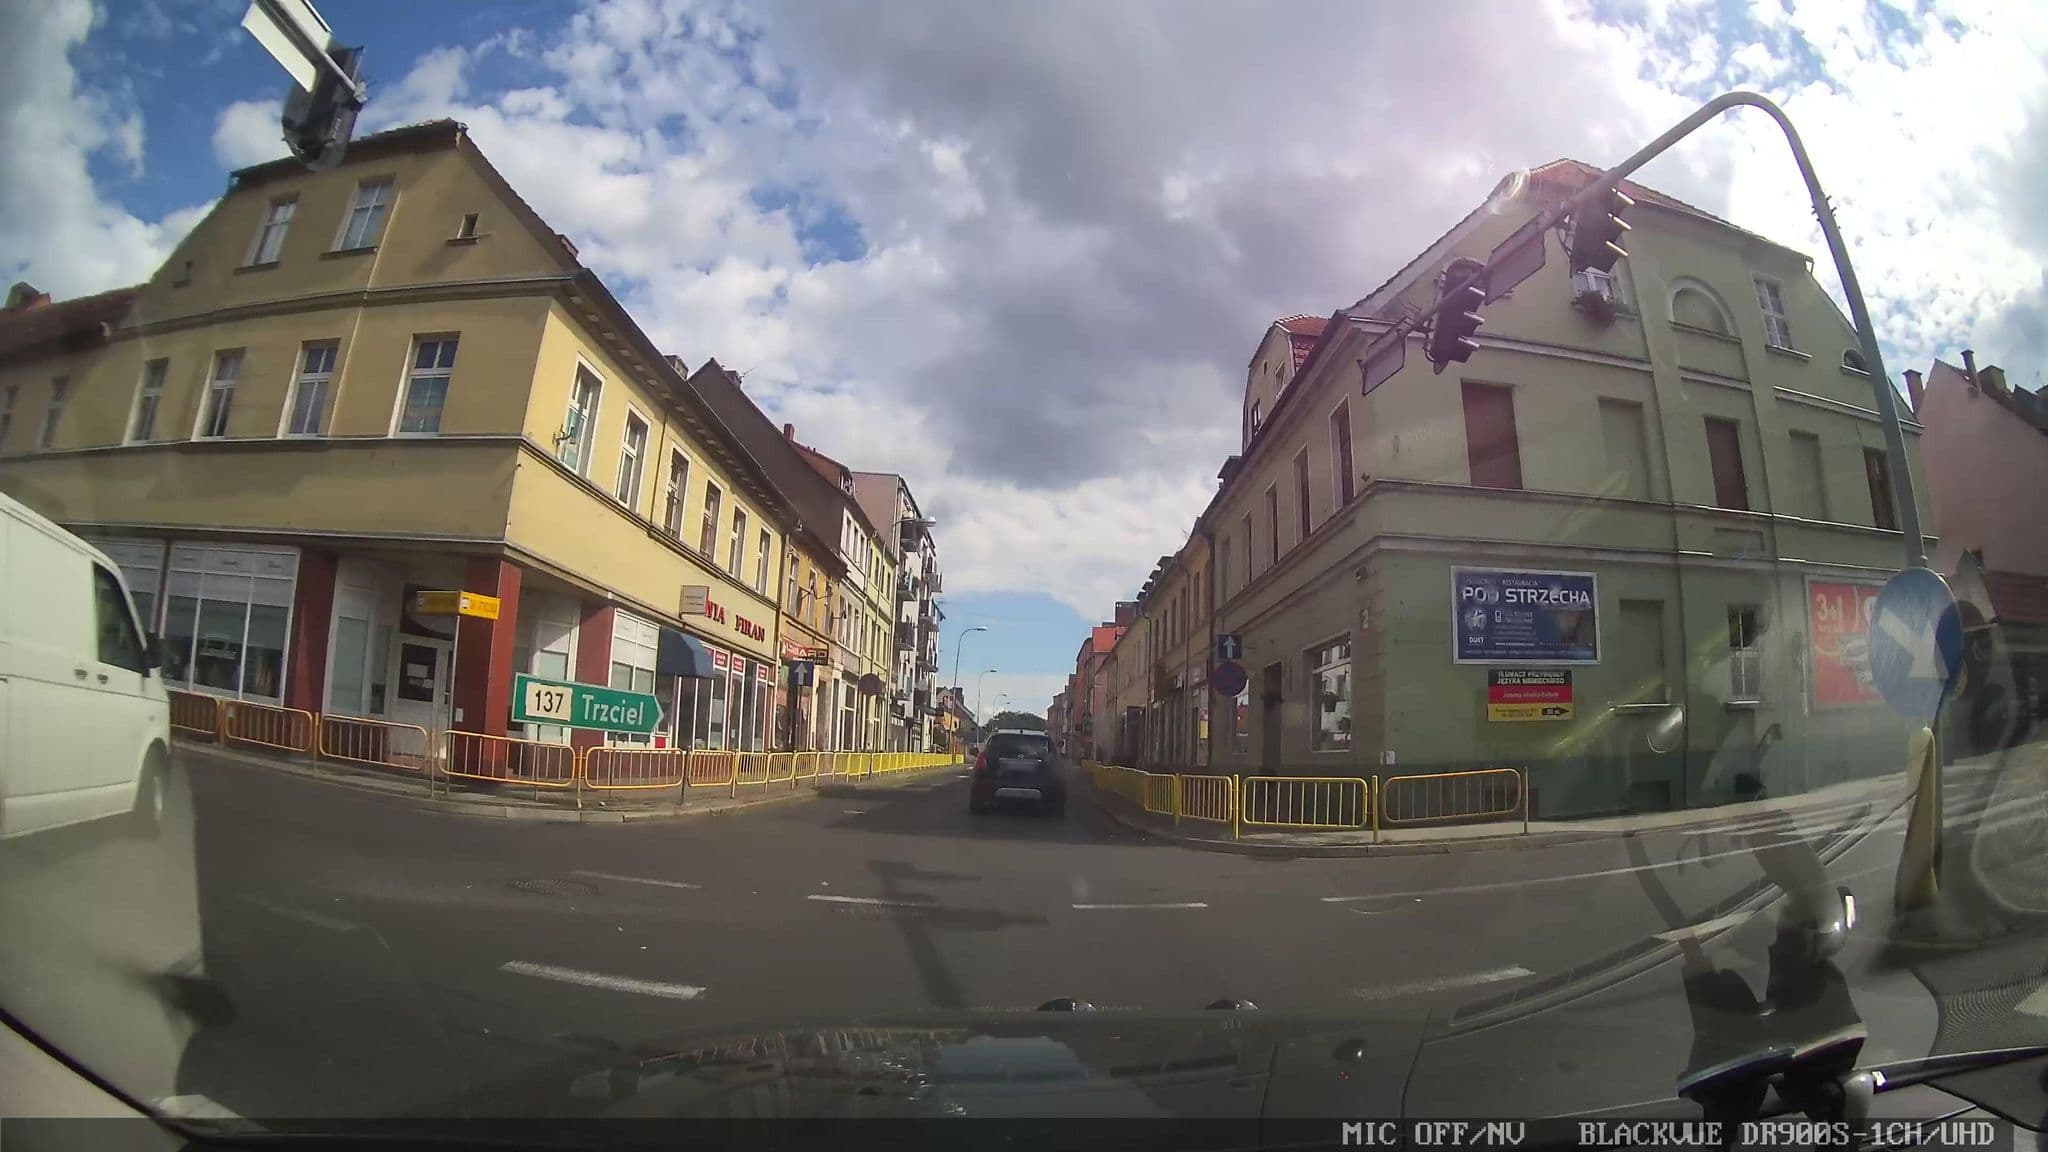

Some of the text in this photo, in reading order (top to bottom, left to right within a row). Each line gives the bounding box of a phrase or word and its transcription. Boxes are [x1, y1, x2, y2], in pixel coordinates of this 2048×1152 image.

[735, 614, 765, 642] FIRAN
[1362, 608, 1369, 629] 2
[535, 689, 564, 714] 137
[582, 694, 644, 726] Trzciel
